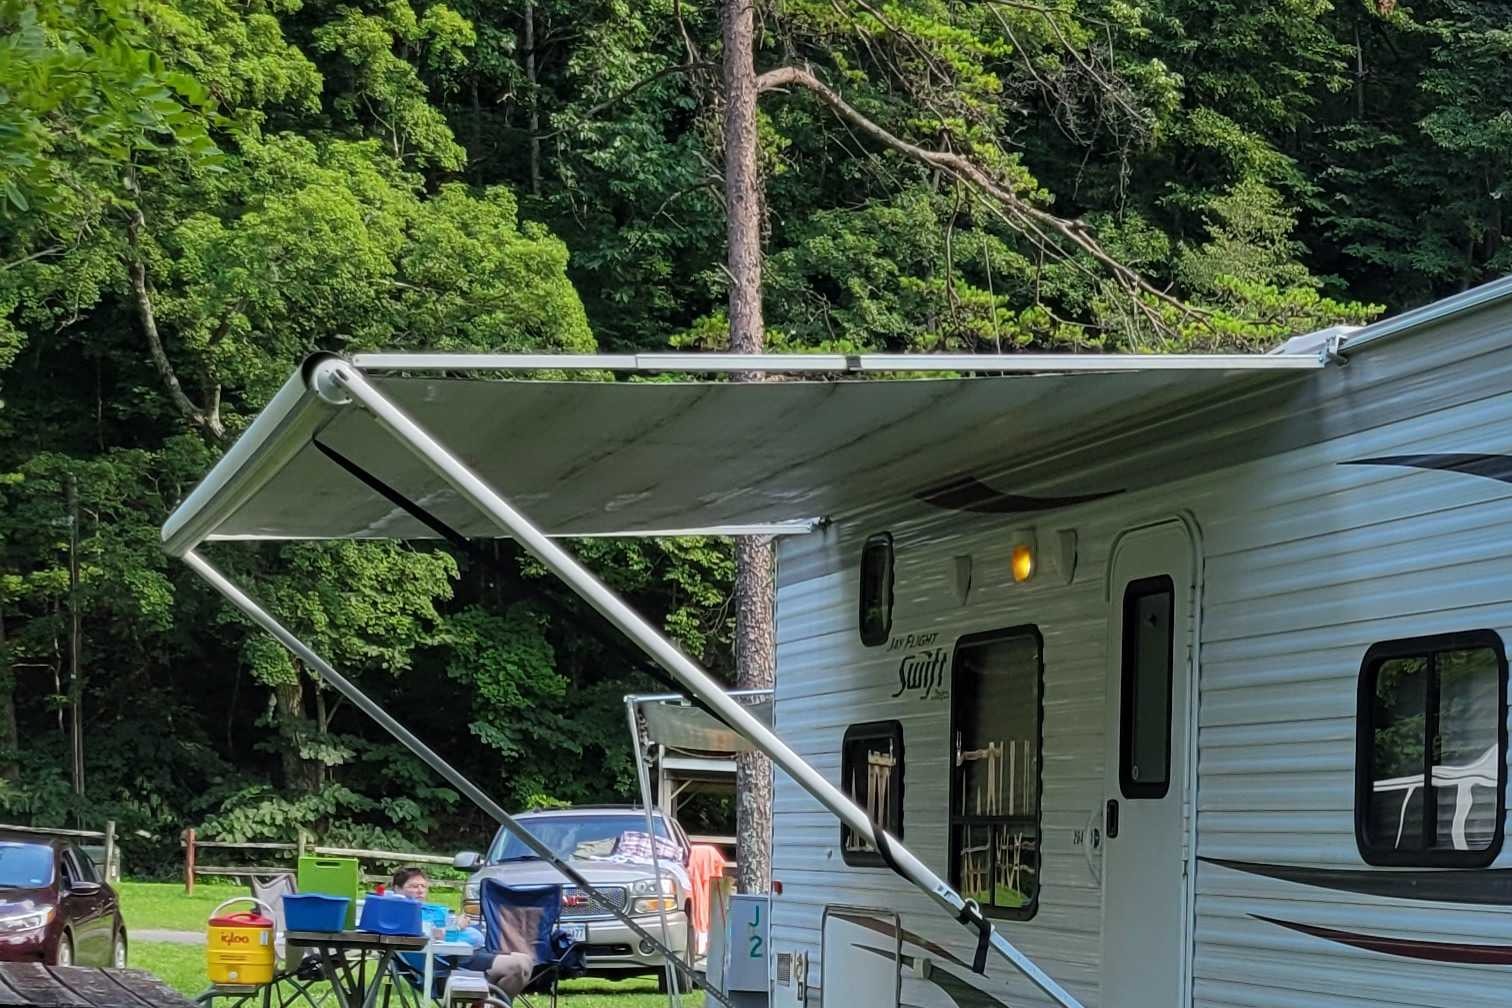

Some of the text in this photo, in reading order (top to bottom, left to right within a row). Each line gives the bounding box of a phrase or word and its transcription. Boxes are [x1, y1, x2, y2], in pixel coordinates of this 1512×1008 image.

[887, 632, 939, 652] JAY FLIGHT
[891, 648, 948, 700] Swift
[748, 904, 760, 928] J
[220, 931, 251, 947] igloo
[749, 935, 763, 958] 2
